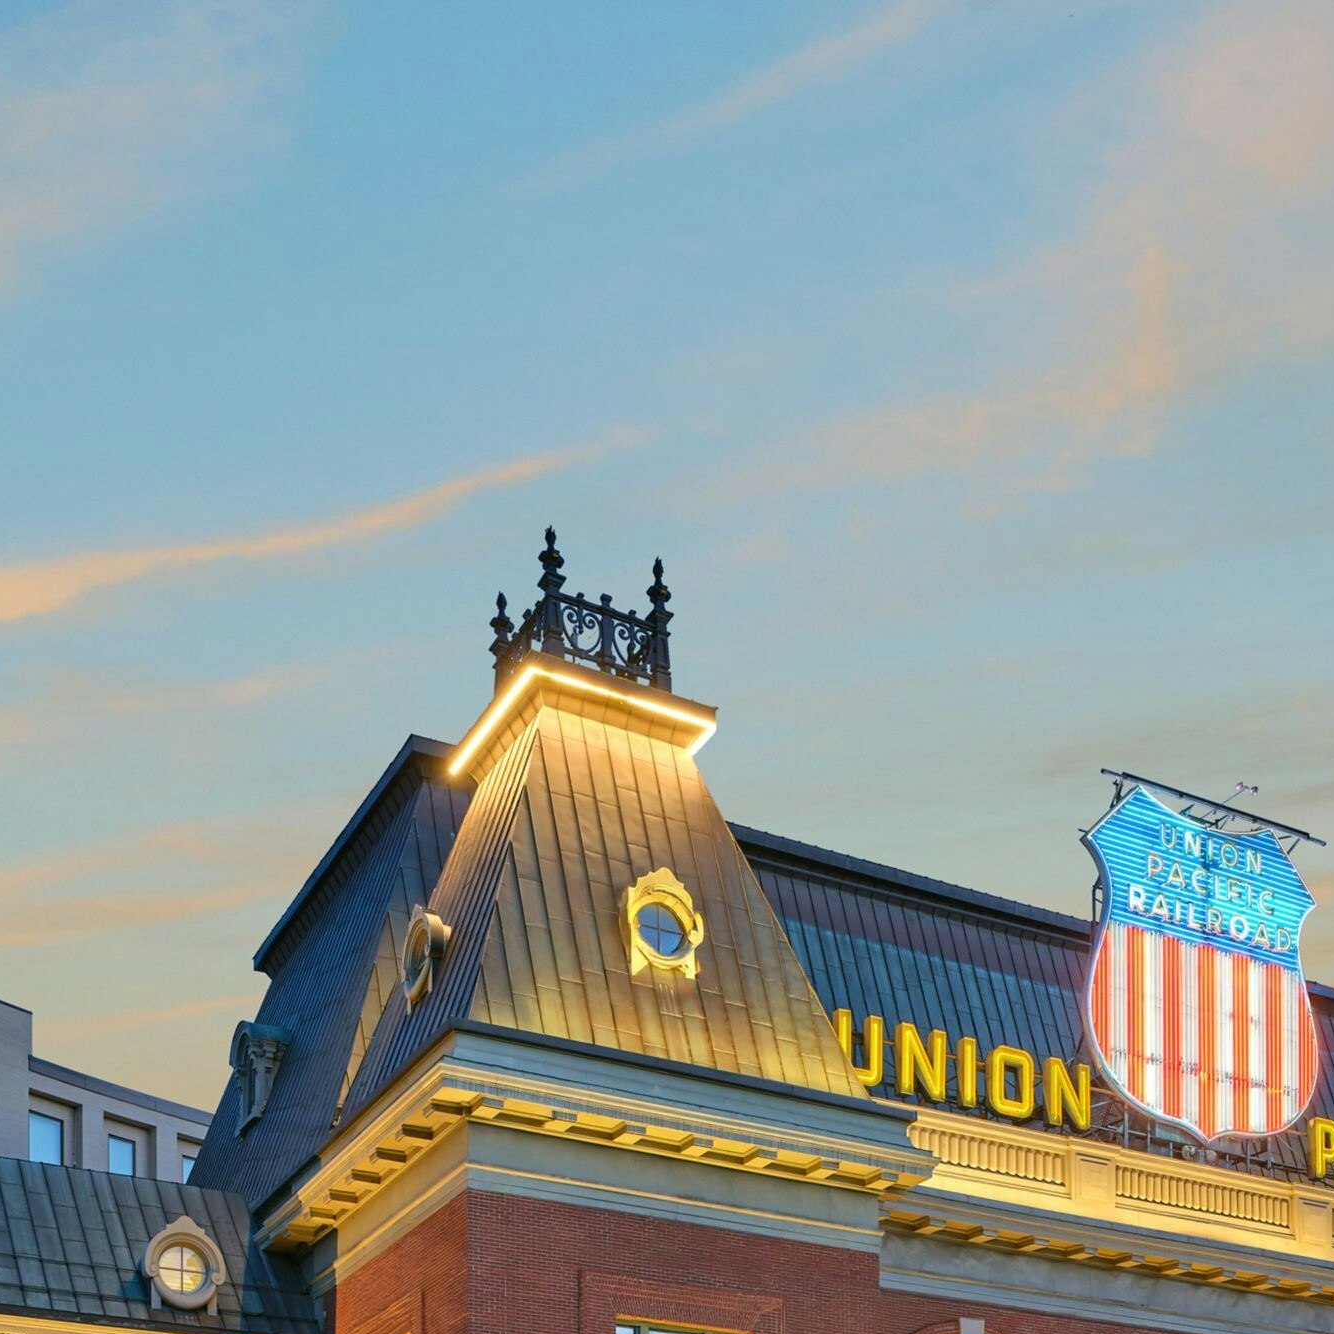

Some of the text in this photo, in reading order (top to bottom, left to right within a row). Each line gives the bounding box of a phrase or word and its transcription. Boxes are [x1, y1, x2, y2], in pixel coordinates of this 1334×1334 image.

[1160, 823, 1262, 877] UNION
[1146, 852, 1276, 915] PACIFIC
[1128, 884, 1293, 952] RAILROAD
[832, 1008, 1091, 1131] UNION
